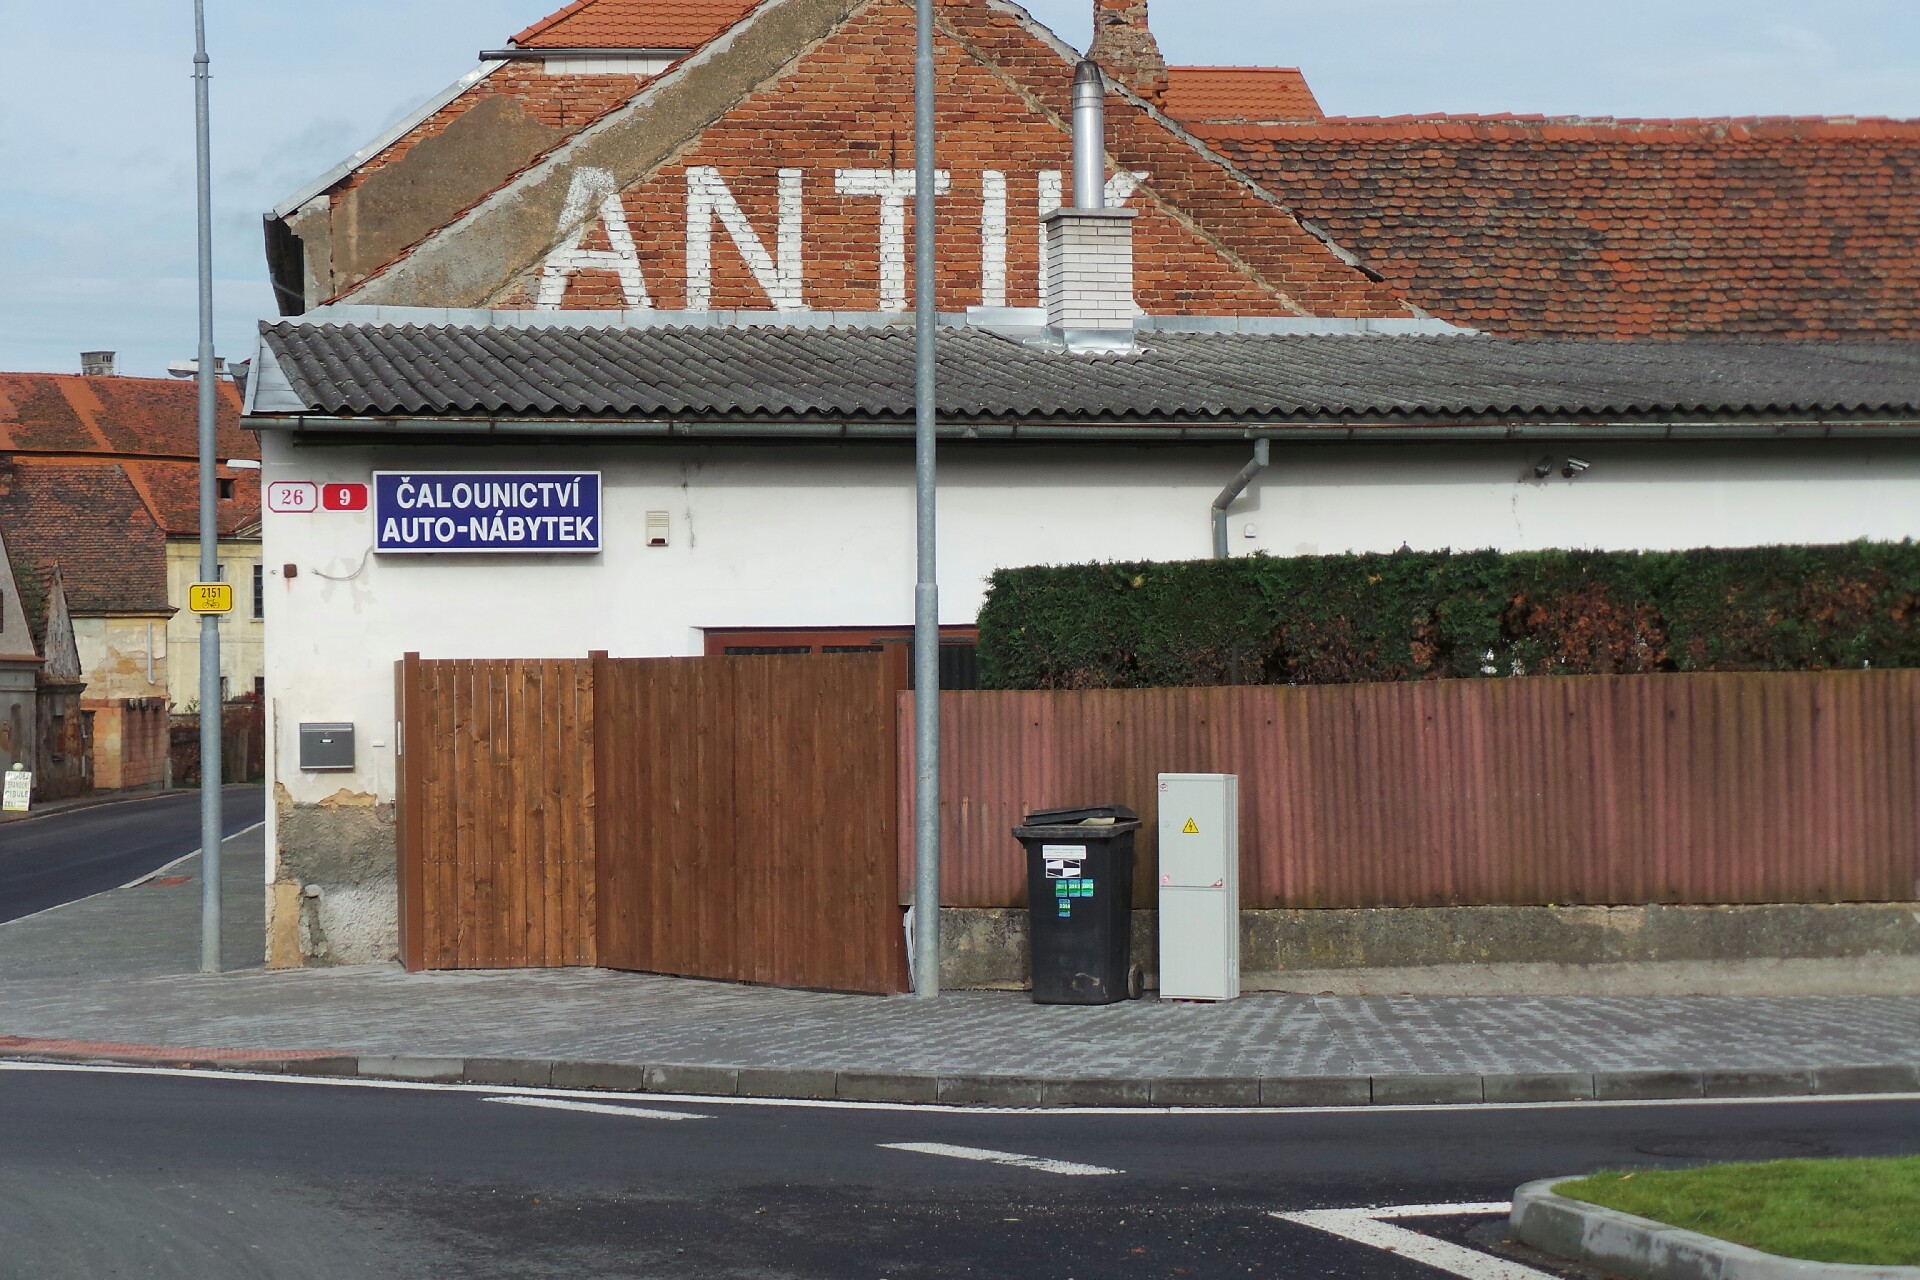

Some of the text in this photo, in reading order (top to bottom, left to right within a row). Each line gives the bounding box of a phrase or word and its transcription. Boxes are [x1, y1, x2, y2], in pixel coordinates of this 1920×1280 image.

[282, 488, 303, 505] 26
[339, 488, 351, 506] 9
[396, 476, 581, 508] ČALOUNICTVÍ
[382, 510, 595, 543] AUTO-NÁBYTEK
[201, 587, 221, 598] 2151
